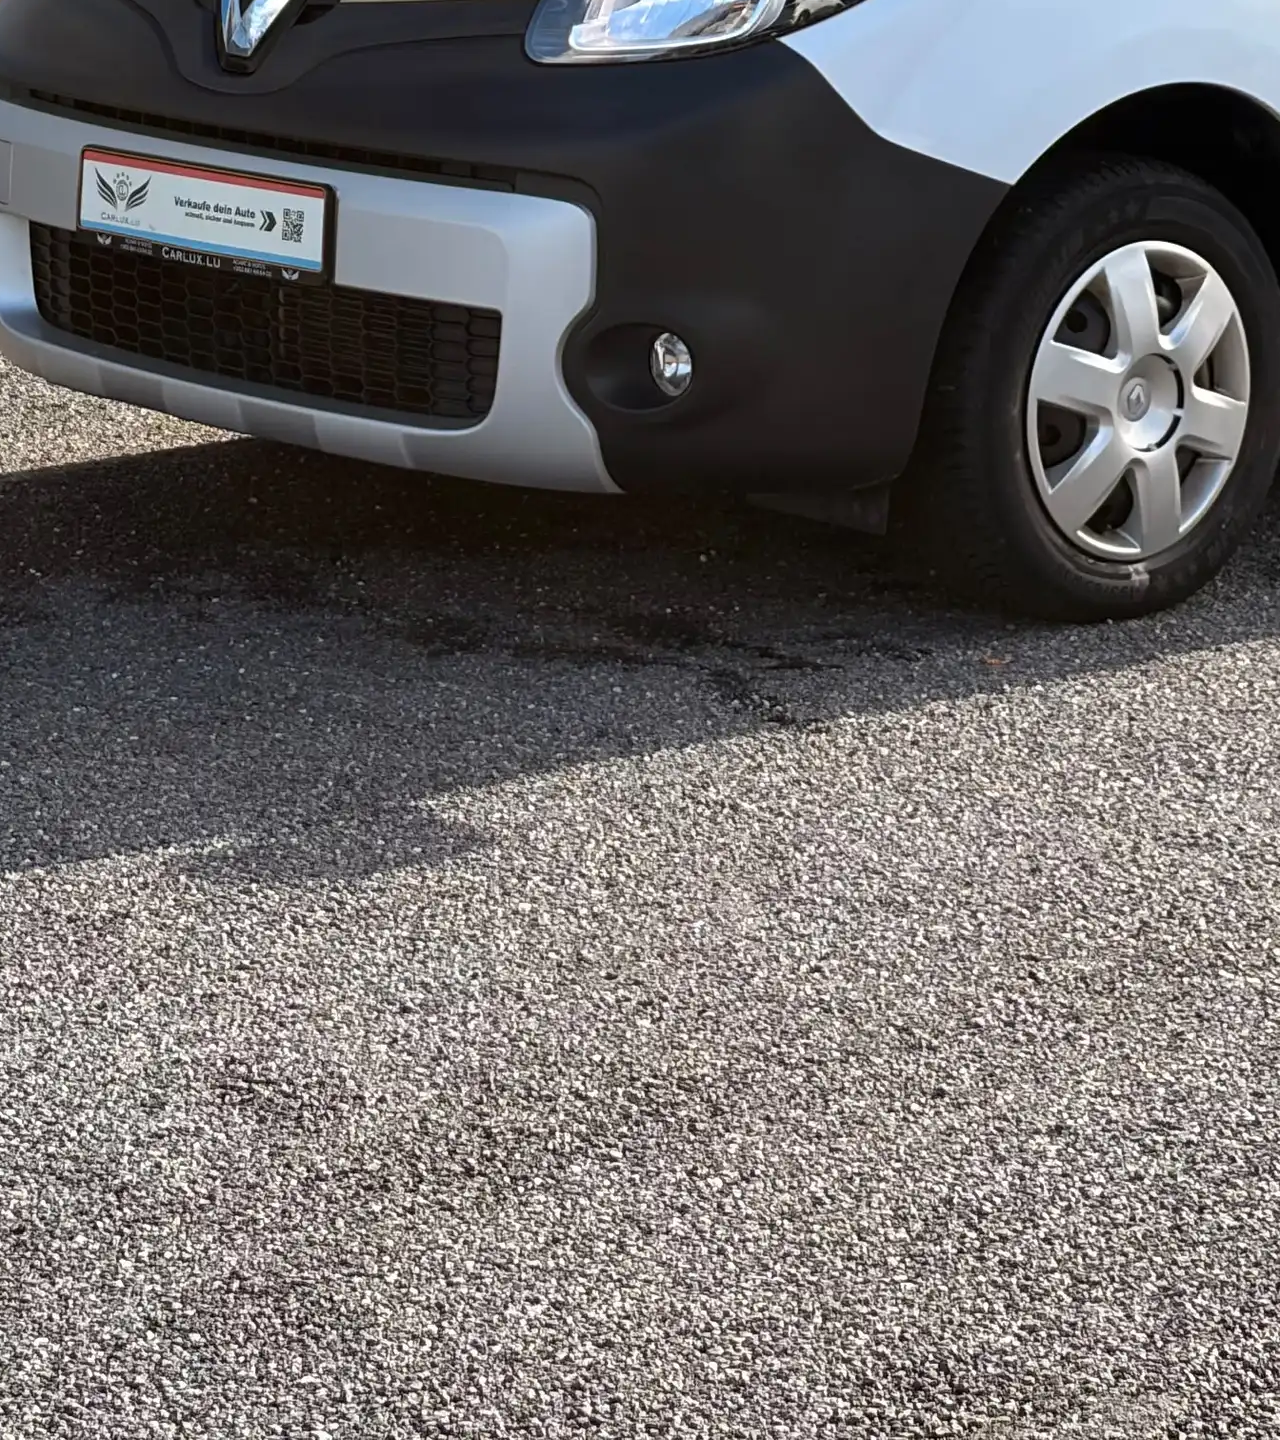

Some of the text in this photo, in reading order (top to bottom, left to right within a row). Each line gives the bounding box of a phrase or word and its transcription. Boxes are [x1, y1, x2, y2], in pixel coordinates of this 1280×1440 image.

[174, 196, 257, 219] Verkaufe dein Auto
[161, 246, 222, 269] CARLUX.LU
